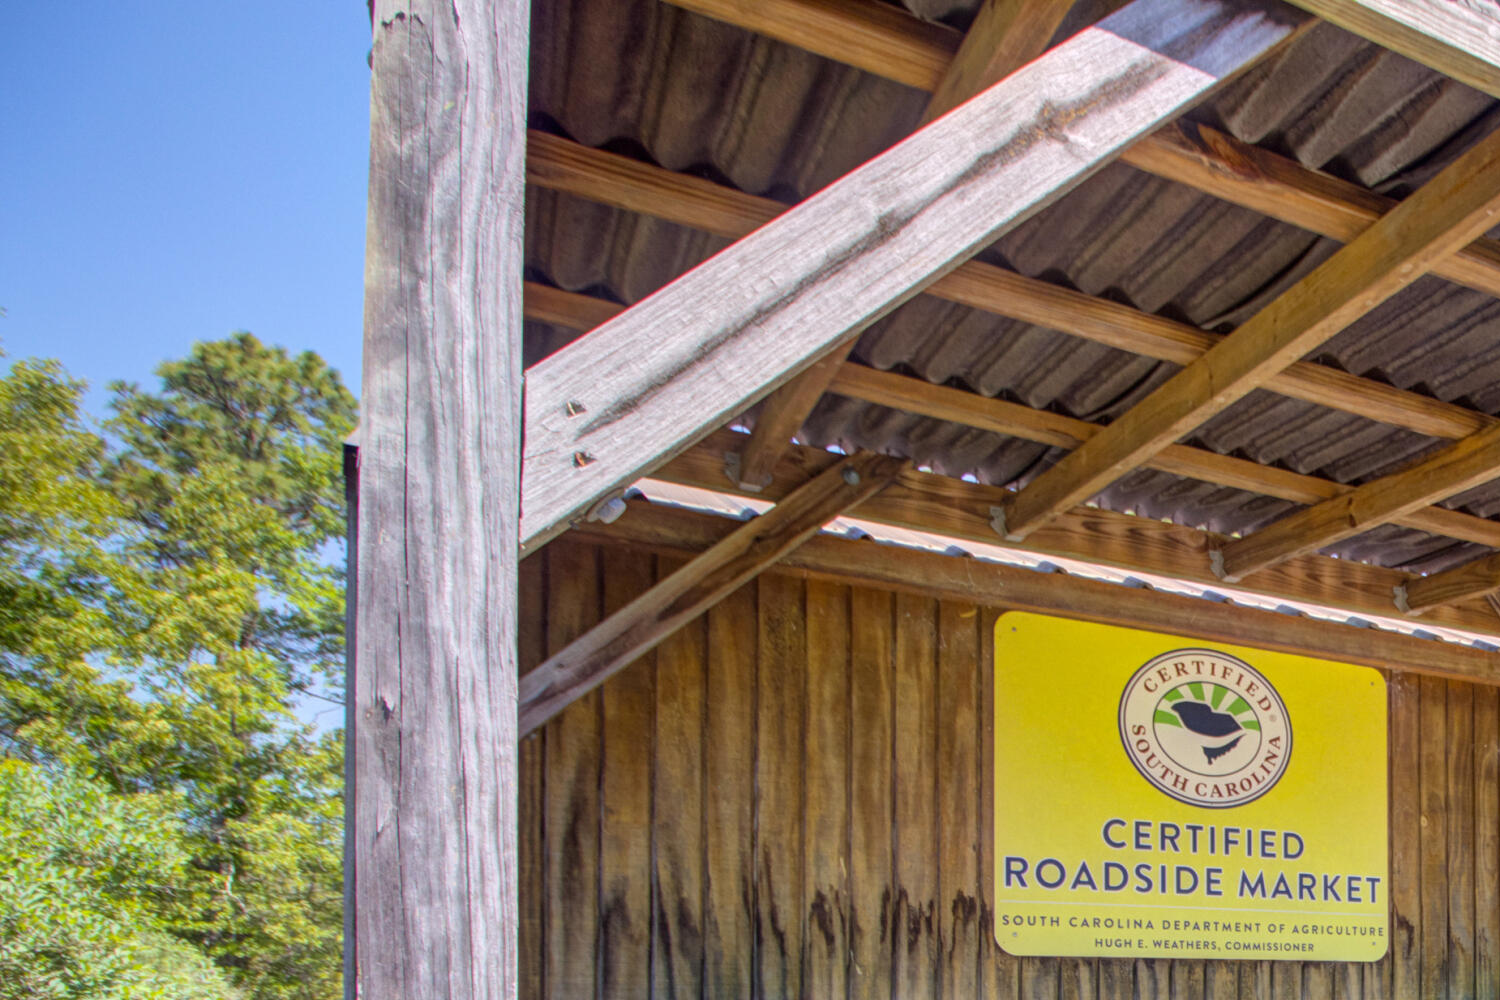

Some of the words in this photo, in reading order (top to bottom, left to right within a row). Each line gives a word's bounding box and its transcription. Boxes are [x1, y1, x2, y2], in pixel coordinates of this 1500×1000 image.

[1143, 660, 1272, 712] CERTIFIED
[1132, 724, 1189, 792] SOUTH
[1194, 736, 1281, 798] CAROLINA
[1102, 818, 1305, 860] CERTIFIED
[1004, 856, 1223, 897] ROADSIDE
[1238, 869, 1381, 904] MARKET
[1002, 914, 1060, 927] SOUTH
[1069, 917, 1154, 930] CAROLINA
[1162, 919, 1261, 933] DEPARTMENT
[1267, 923, 1286, 934] OF
[1292, 924, 1384, 937] AGRICULTURE
[1095, 938, 1132, 949] HUGH
[1137, 939, 1148, 949] E.
[1152, 939, 1221, 952] WEATHERS,
[1225, 941, 1315, 953] COMMISSIONER
